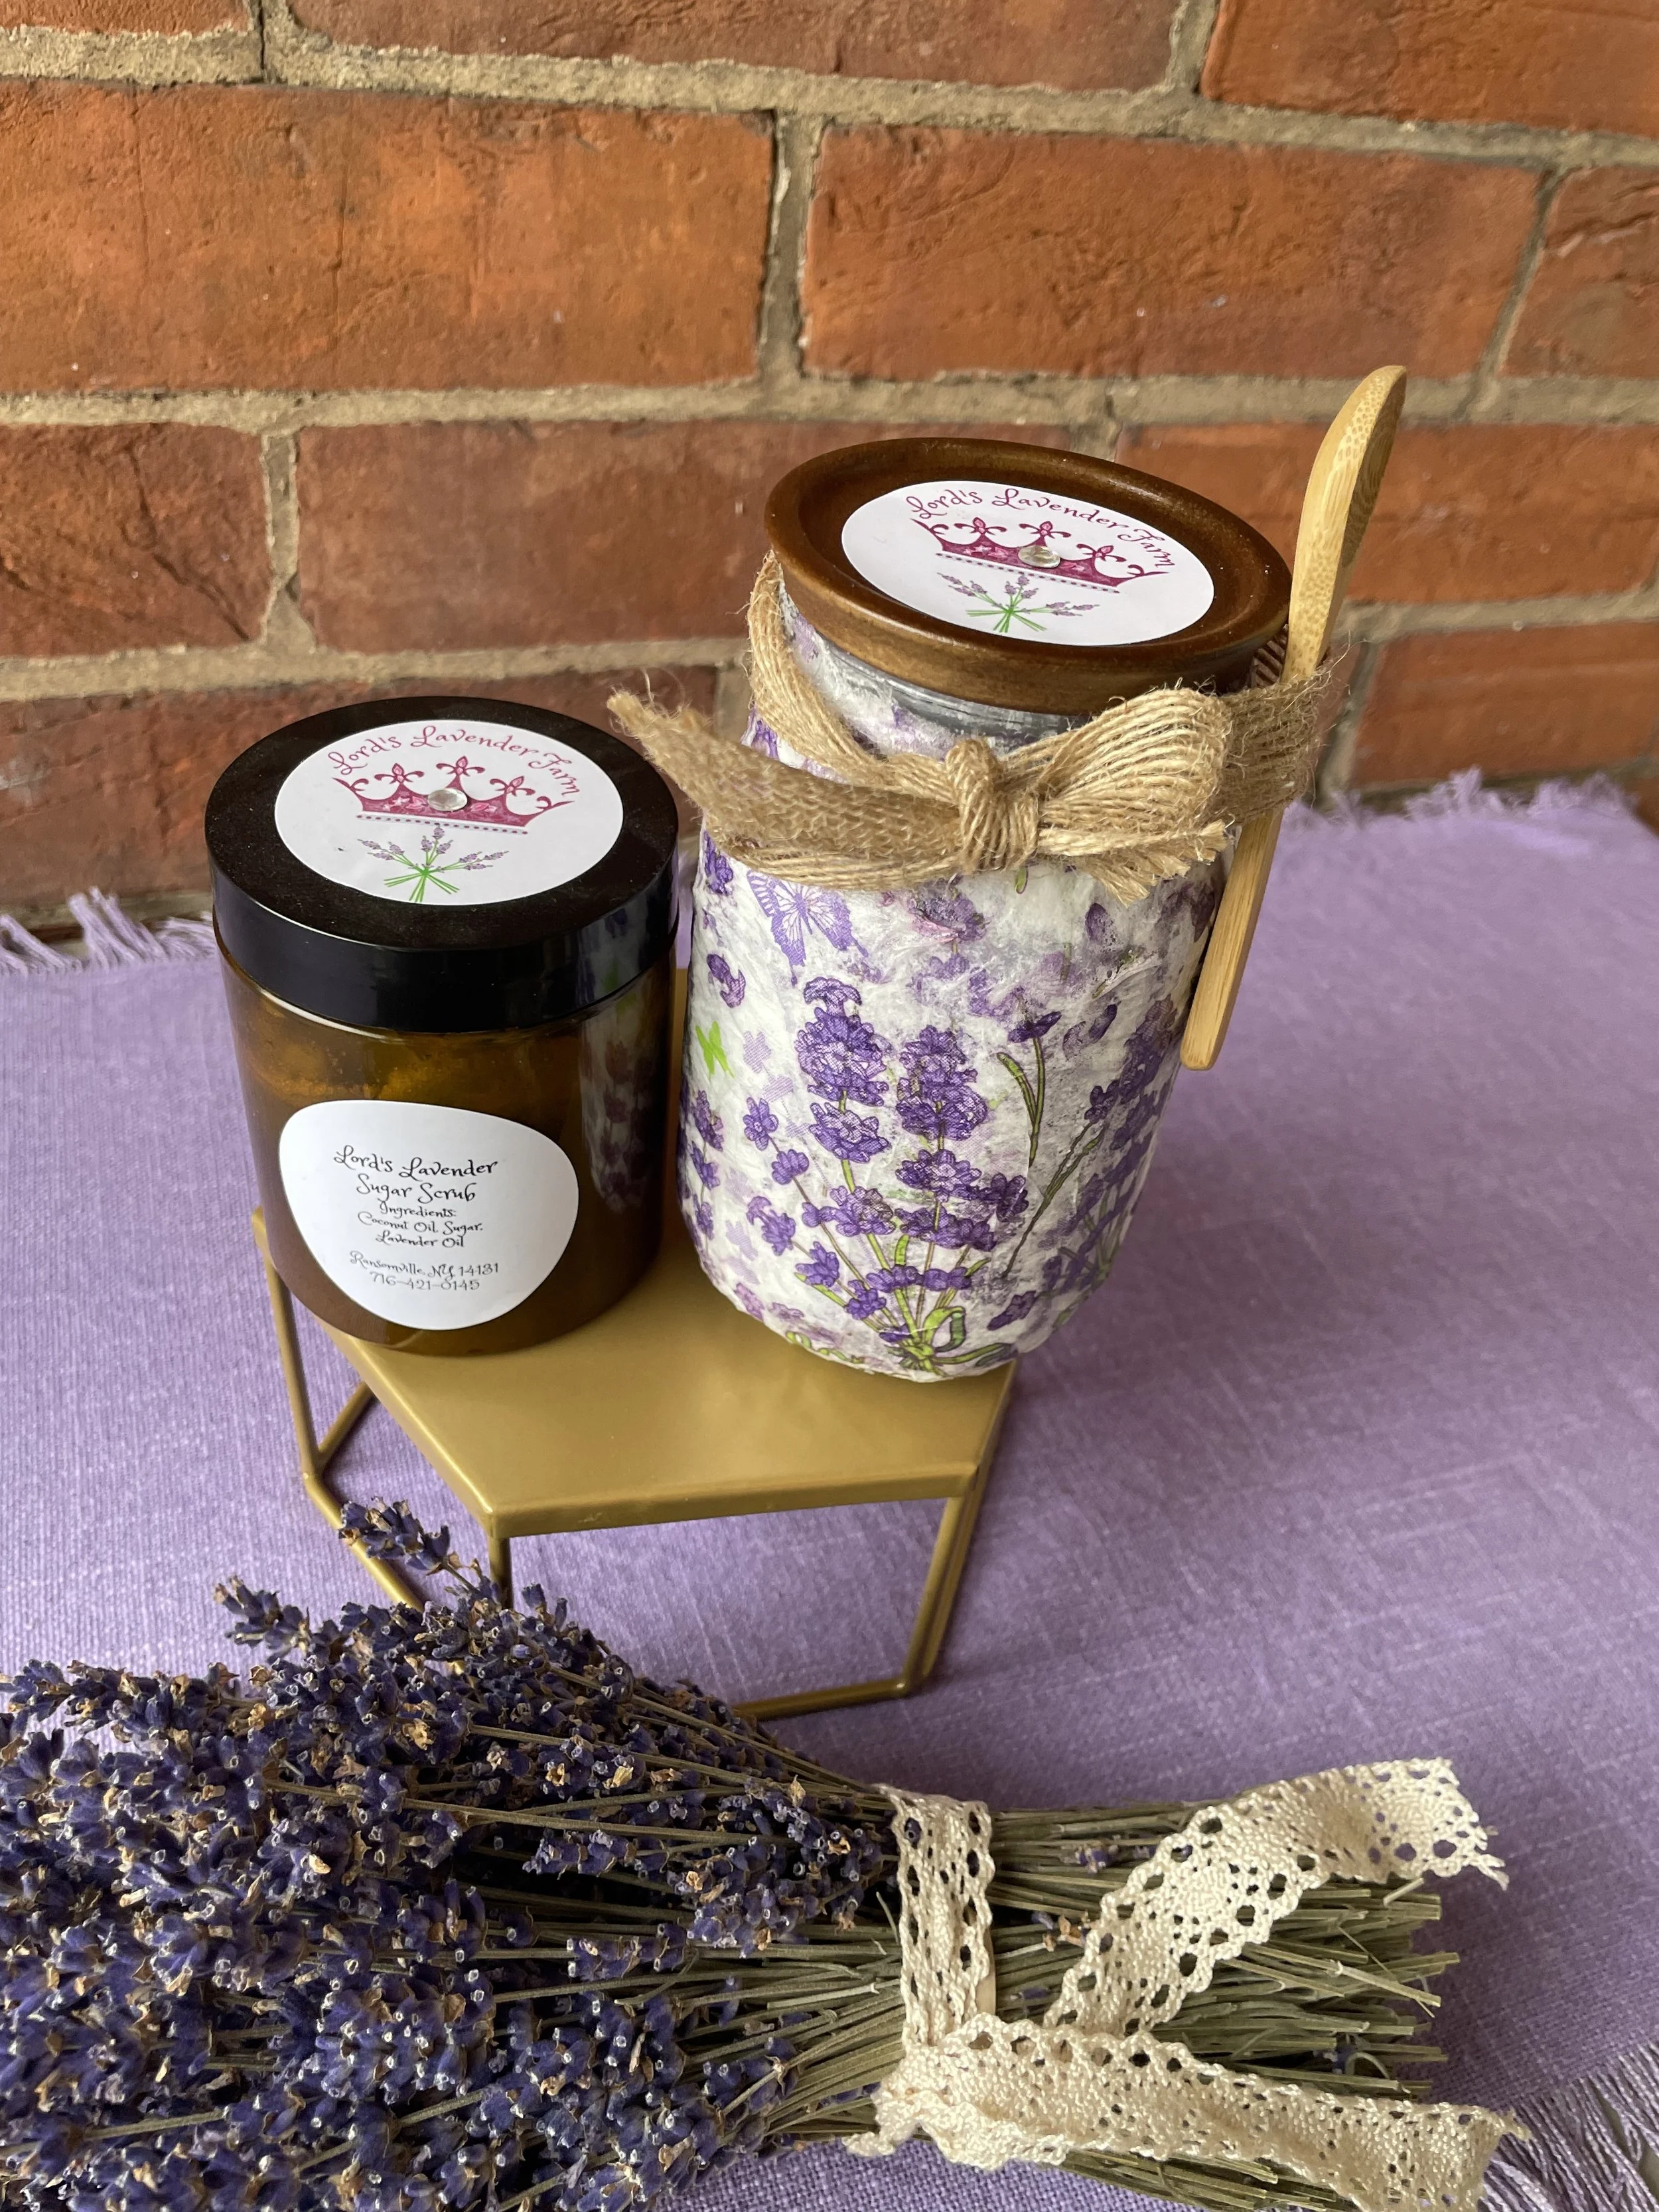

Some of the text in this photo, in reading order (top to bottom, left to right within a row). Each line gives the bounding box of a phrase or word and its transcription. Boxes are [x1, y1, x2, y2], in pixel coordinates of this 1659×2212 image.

[906, 488, 1176, 567] Lord's Lavender Farm
[328, 725, 581, 797] Lord's Lavender Farm
[333, 1145, 498, 1182] Lord's Lavender
[356, 1173, 476, 1204] Sugar Scrub
[358, 1211, 409, 1229] Coconut
[379, 1200, 457, 1218] Ingredients:
[375, 1230, 465, 1248] Lavender Oil
[459, 1262, 499, 1276] 14131
